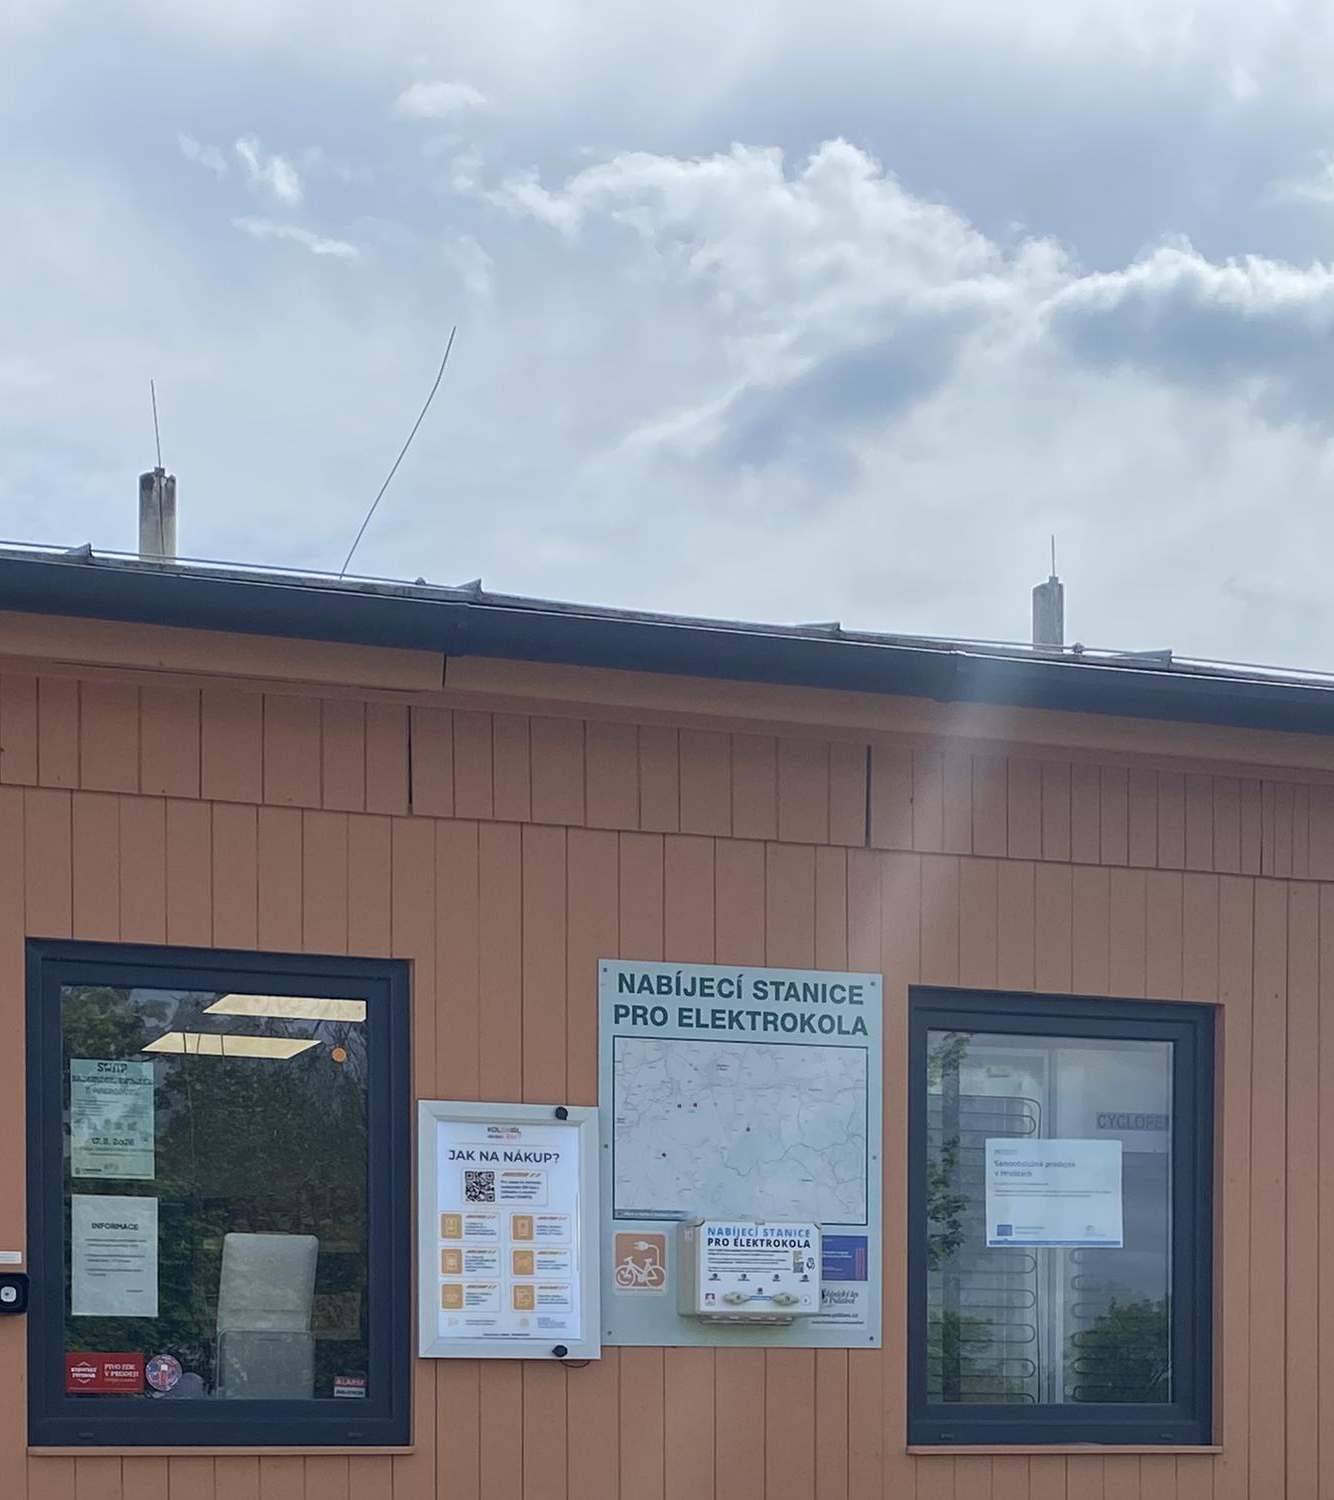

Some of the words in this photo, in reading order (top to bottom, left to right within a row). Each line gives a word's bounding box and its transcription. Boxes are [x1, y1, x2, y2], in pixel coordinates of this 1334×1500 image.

[618, 970, 744, 1000] NABÍJECÍ
[752, 980, 864, 1006] STANICE
[614, 1004, 668, 1027] PRO
[678, 1007, 869, 1036] ELEKTROKOLA
[1097, 1113, 1170, 1131] CYCLOPE
[448, 1150, 475, 1161] JAK
[479, 1151, 499, 1162] NA
[503, 1149, 560, 1163] NÁKUP?
[91, 1222, 139, 1231] INFORMACE
[707, 1225, 759, 1238] NABÍJECÍ
[763, 1228, 811, 1238] STANICE
[707, 1237, 730, 1247] PRO
[733, 1238, 811, 1249] ELEKTROKOLA
